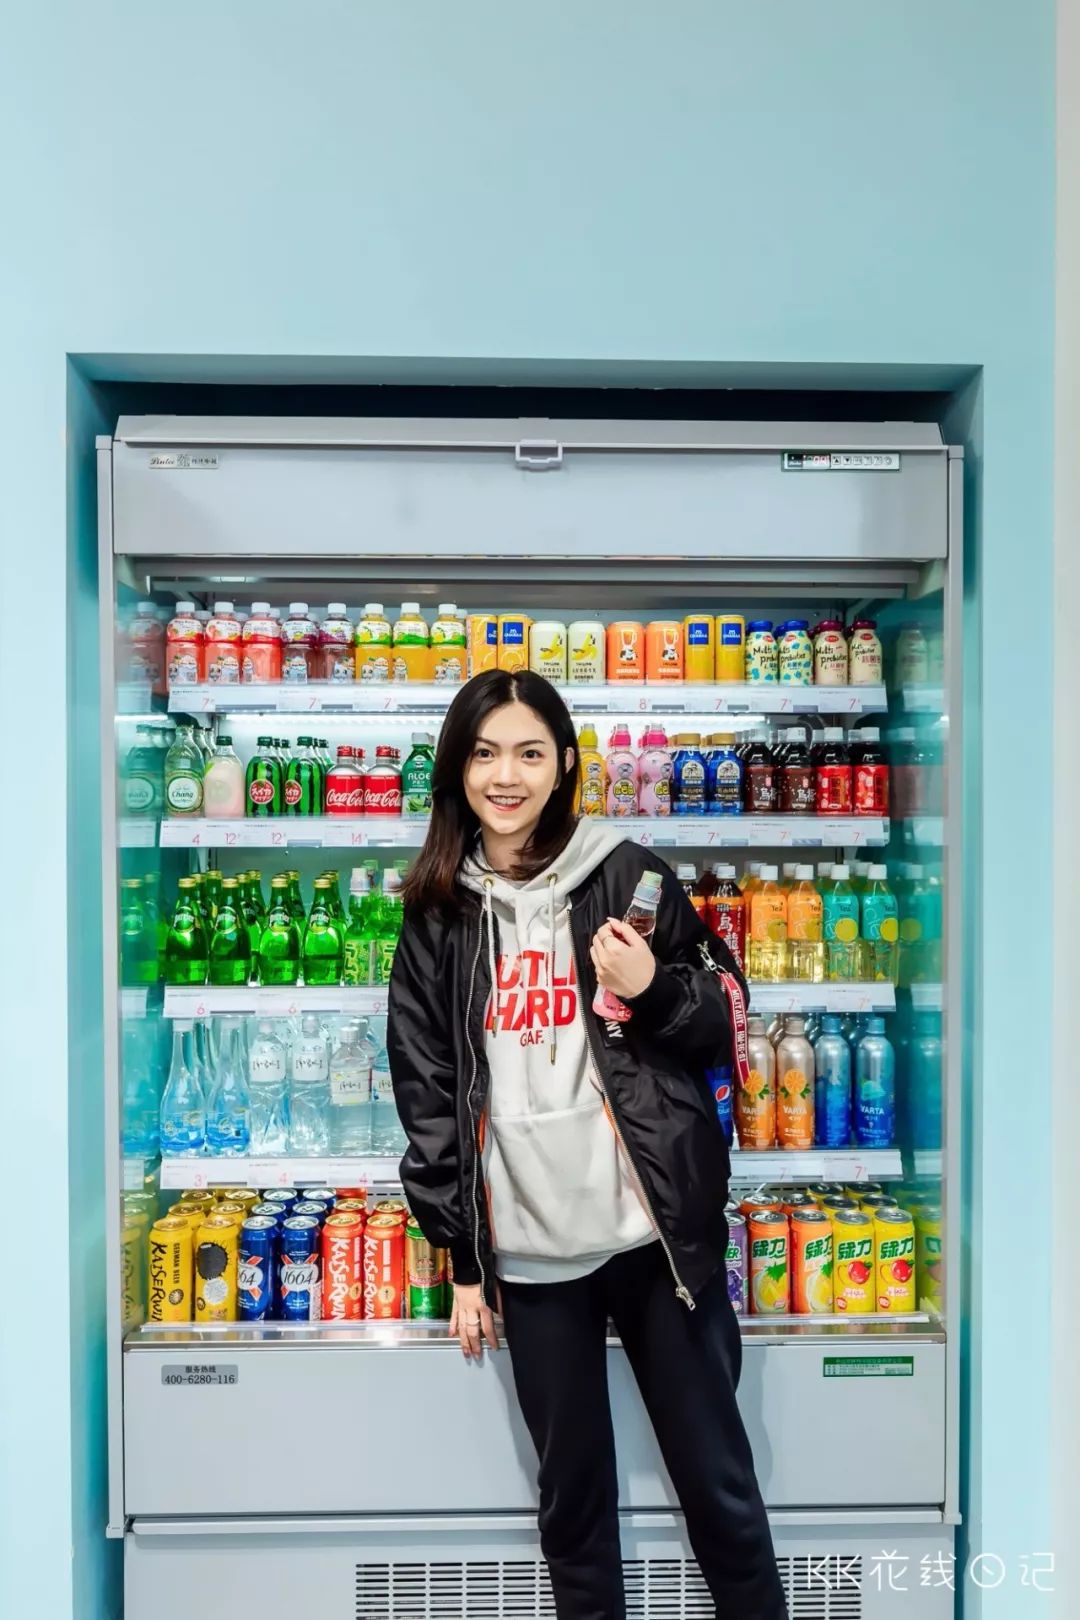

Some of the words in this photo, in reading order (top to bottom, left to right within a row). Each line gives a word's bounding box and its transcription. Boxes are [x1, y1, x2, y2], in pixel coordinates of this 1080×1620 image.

[639, 698, 647, 710] 8
[192, 834, 200, 845] 4
[225, 833, 236, 844] 12
[272, 832, 282, 844] 12
[640, 832, 648, 844] 6
[197, 1002, 205, 1015] 6
[860, 1105, 884, 1115] VARTA
[359, 1172, 368, 1185] 4
[284, 1270, 314, 1285] 1664
[185, 1365, 216, 1373] 服务热线
[165, 1375, 235, 1384] 400-6280-116
